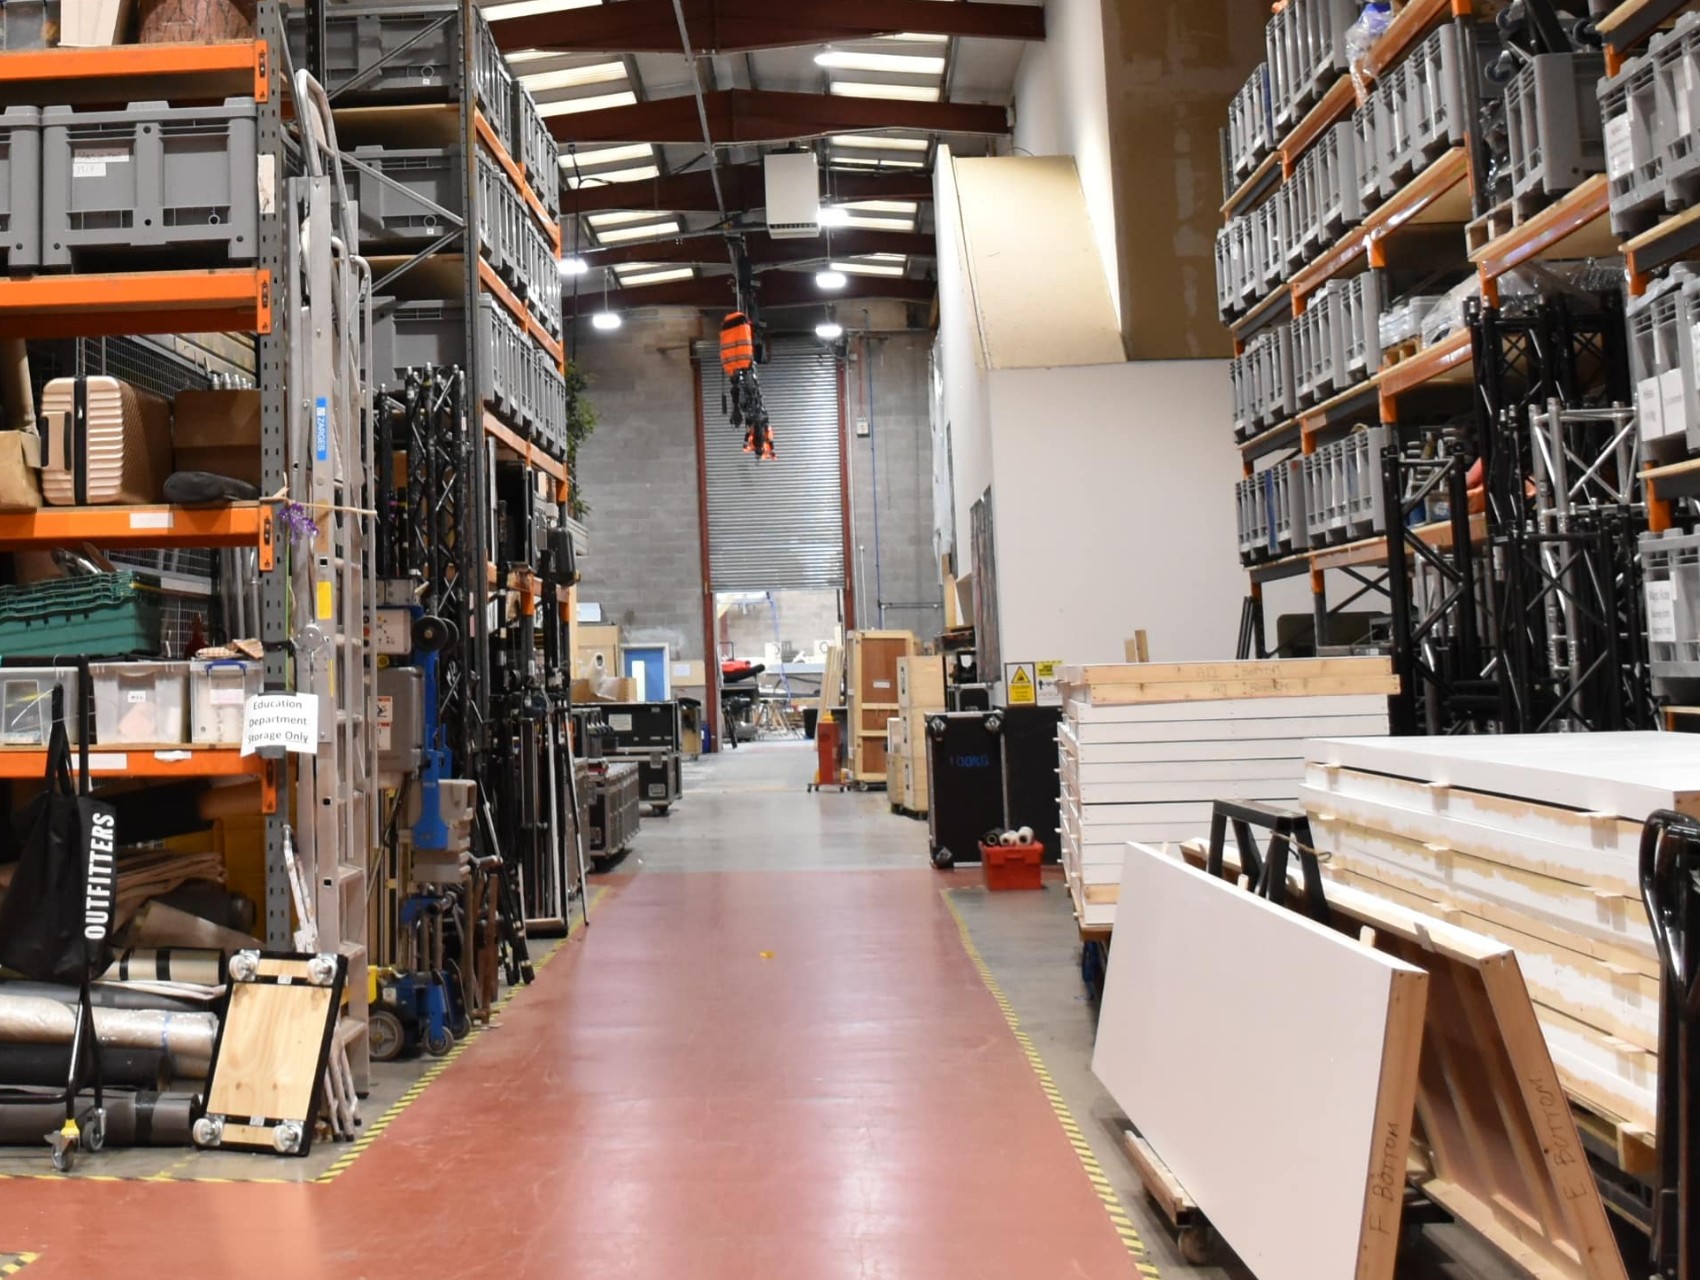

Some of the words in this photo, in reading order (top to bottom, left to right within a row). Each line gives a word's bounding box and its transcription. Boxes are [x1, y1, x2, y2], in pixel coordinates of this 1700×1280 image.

[253, 699, 302, 710] Education
[249, 716, 307, 727] Department
[248, 731, 281, 743] Storage
[285, 731, 308, 743] Only
[84, 812, 115, 940] OUTFITTERS
[1372, 1122, 1400, 1202] BOTTOM
[1562, 1182, 1588, 1201] E
